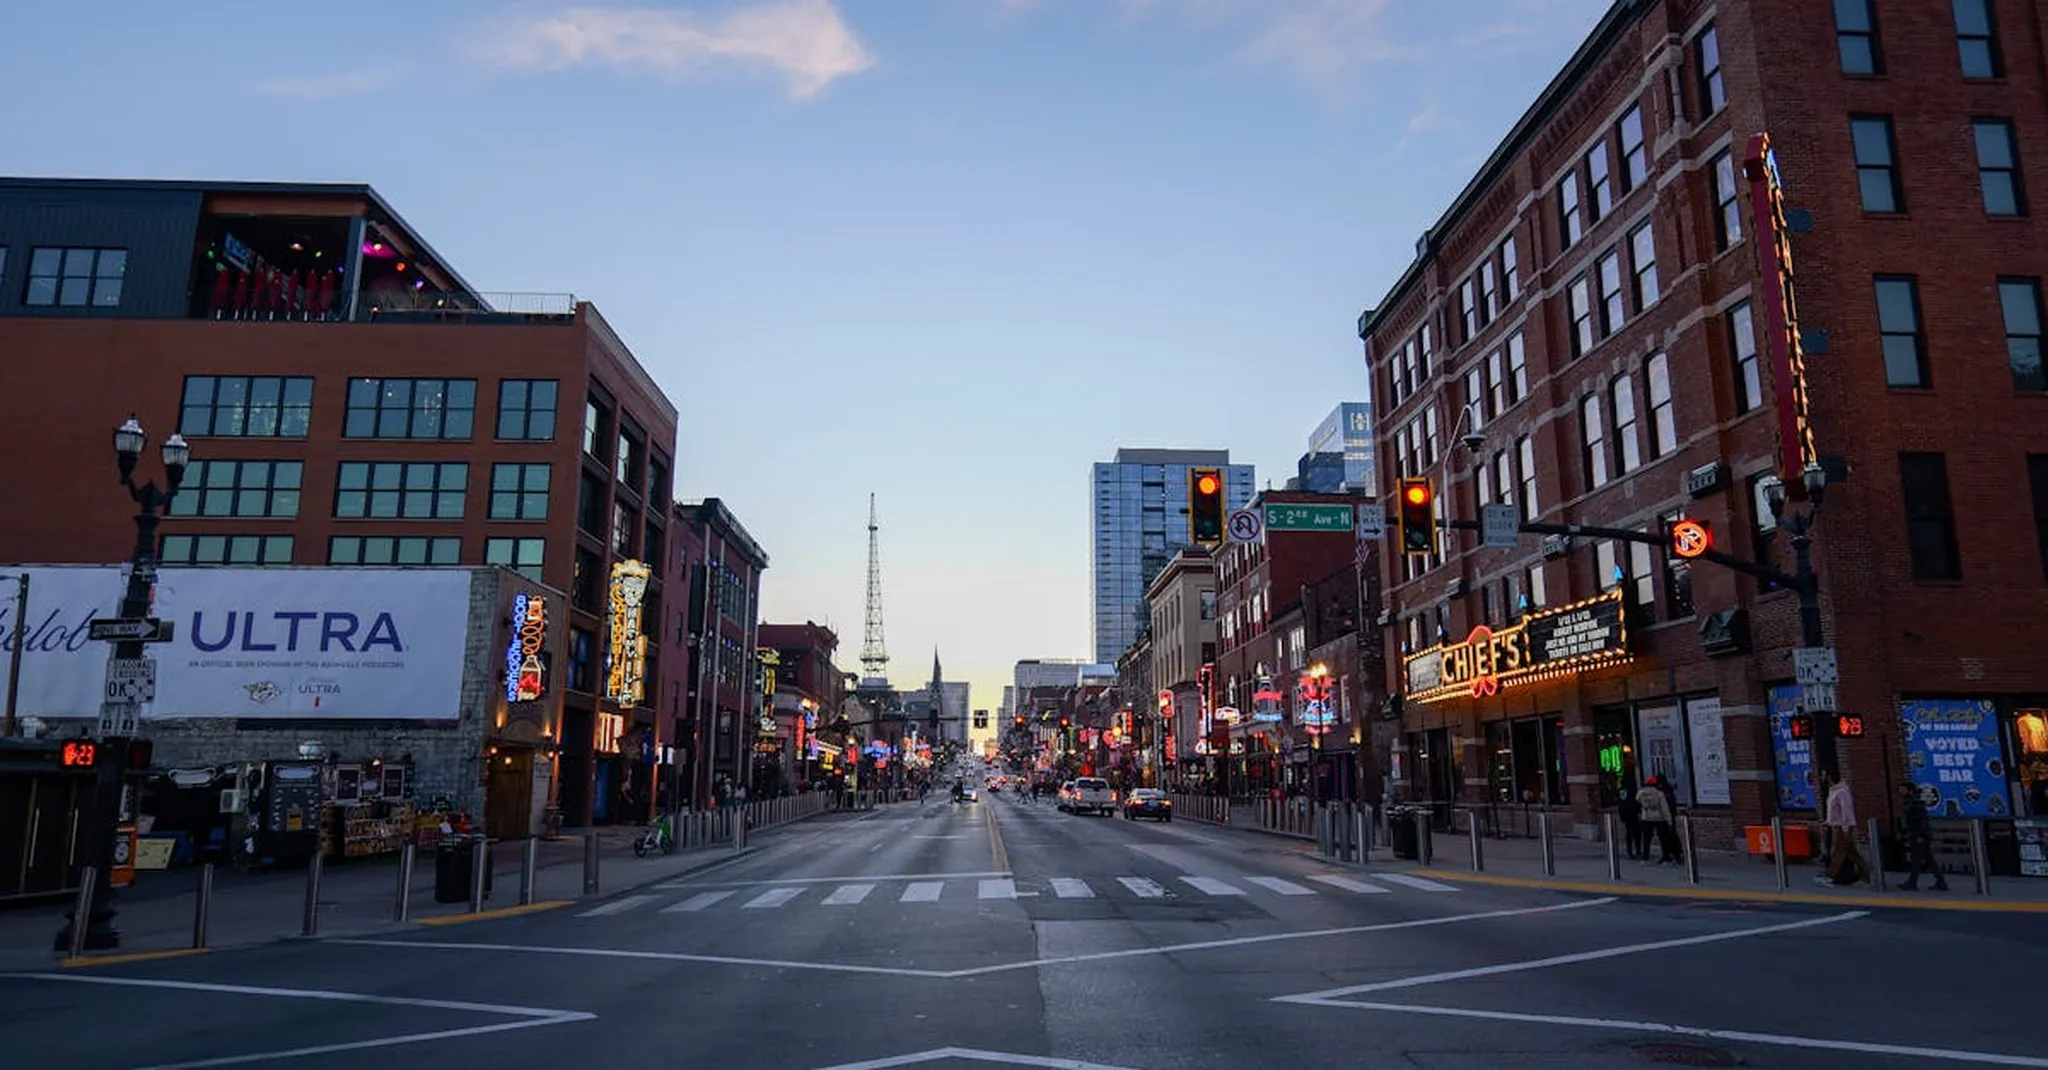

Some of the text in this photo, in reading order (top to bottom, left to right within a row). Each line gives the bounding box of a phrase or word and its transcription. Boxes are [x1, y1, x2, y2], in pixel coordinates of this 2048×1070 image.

[191, 611, 403, 652] ULTRA
[1442, 633, 1520, 683] CHIEF'S
[109, 682, 127, 697] OK
[299, 685, 341, 694] ULTRA
[1925, 736, 1979, 751] VOTED
[76, 745, 94, 765] 23
[1932, 753, 1975, 767] BEST
[1939, 769, 1975, 783] BAR
